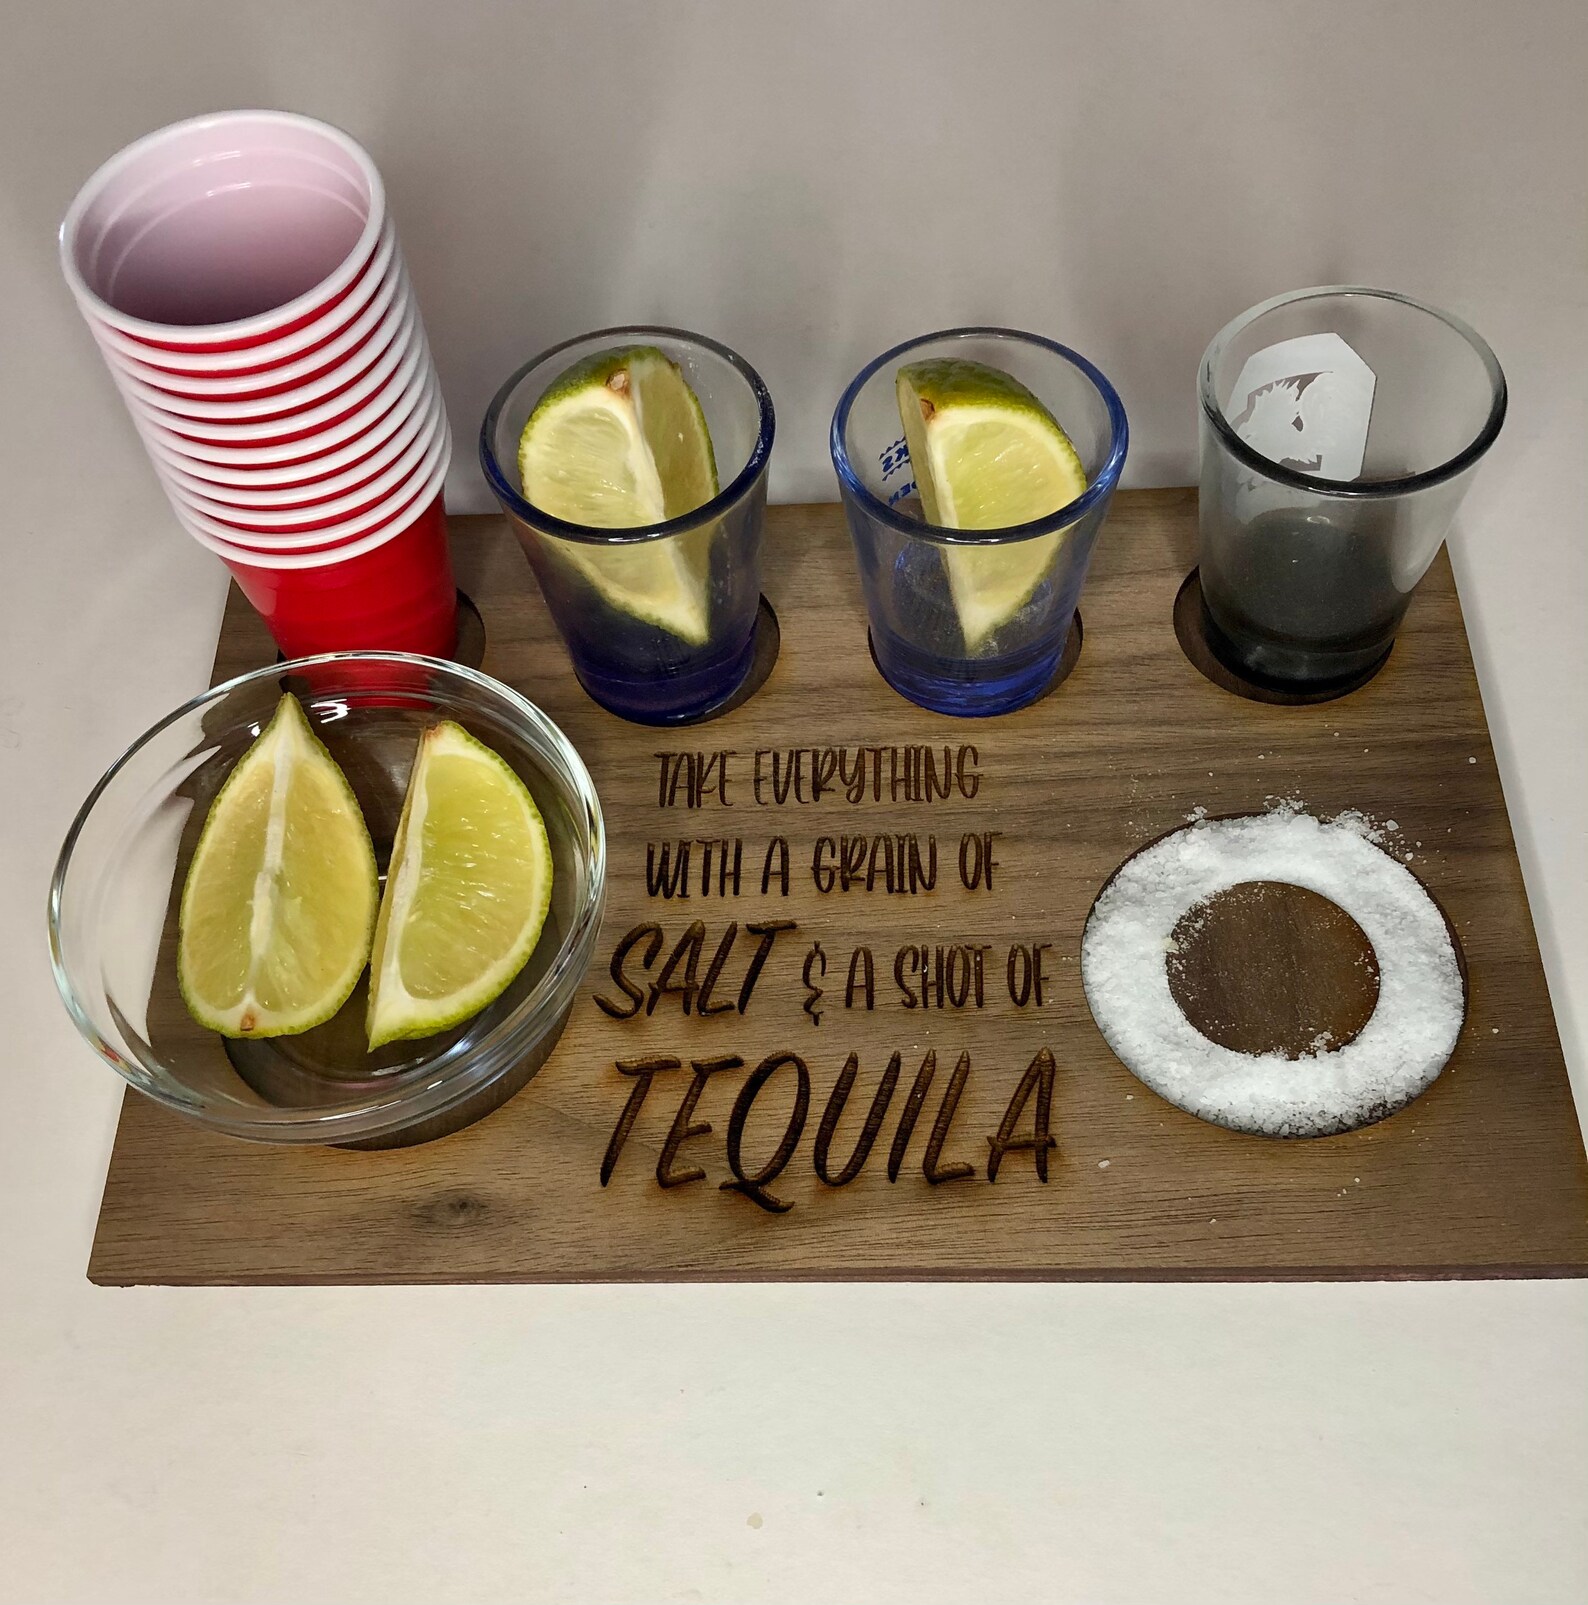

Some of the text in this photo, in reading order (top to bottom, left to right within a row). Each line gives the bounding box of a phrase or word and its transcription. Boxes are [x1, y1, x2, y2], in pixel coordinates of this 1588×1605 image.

[655, 744, 985, 808] TAKE EVERYTHING
[645, 831, 1003, 899] WITH A GRAIN OF
[592, 919, 1053, 1026] SALT & A SHOT OF
[599, 1045, 1057, 1214] TEQUILA
